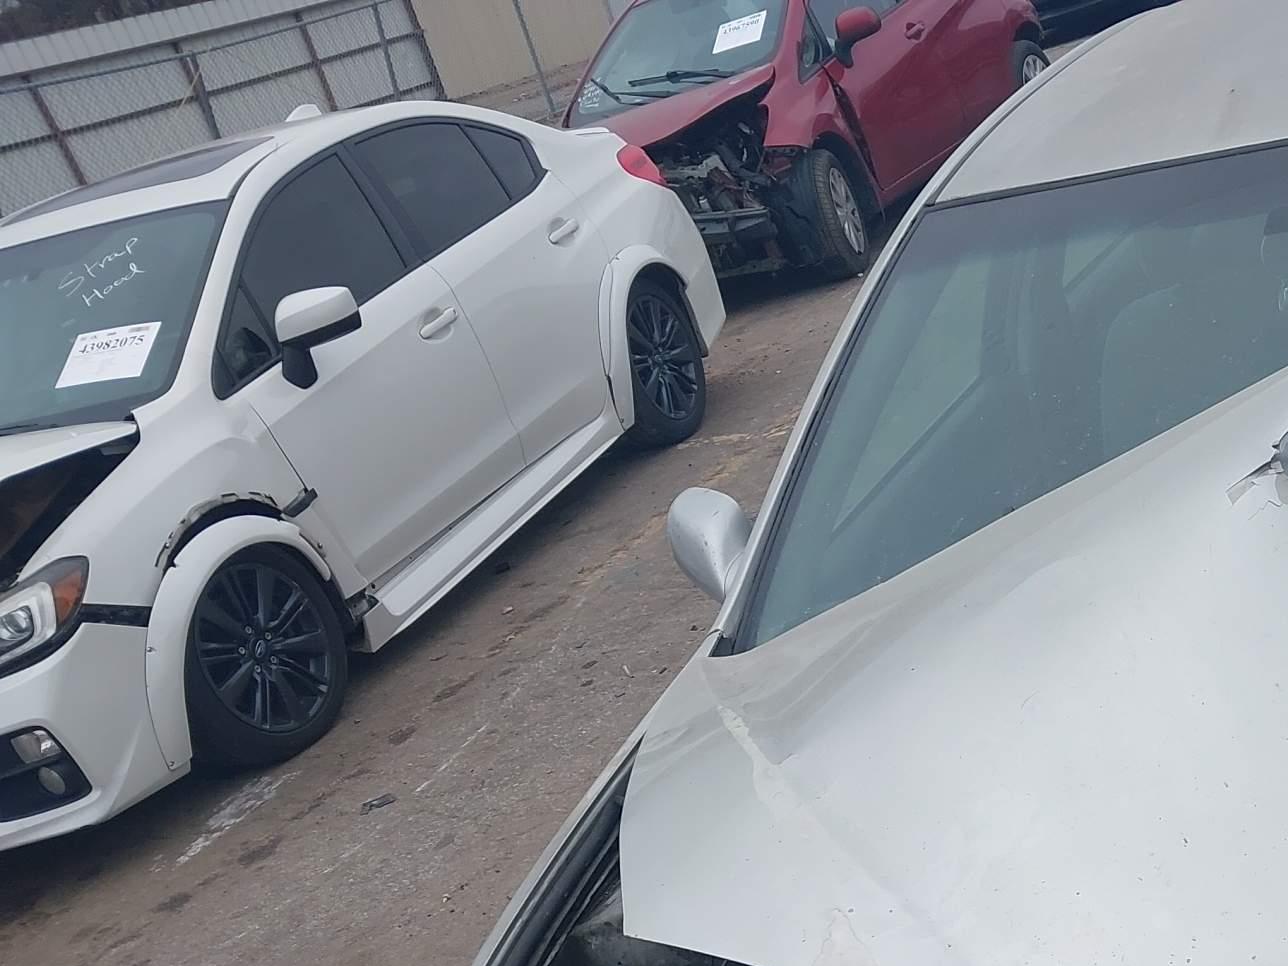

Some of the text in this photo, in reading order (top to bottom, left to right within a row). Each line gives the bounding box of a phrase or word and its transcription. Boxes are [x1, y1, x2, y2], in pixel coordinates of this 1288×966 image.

[57, 237, 138, 297] Strap
[82, 262, 145, 307] Hood
[78, 334, 145, 354] 43982075
